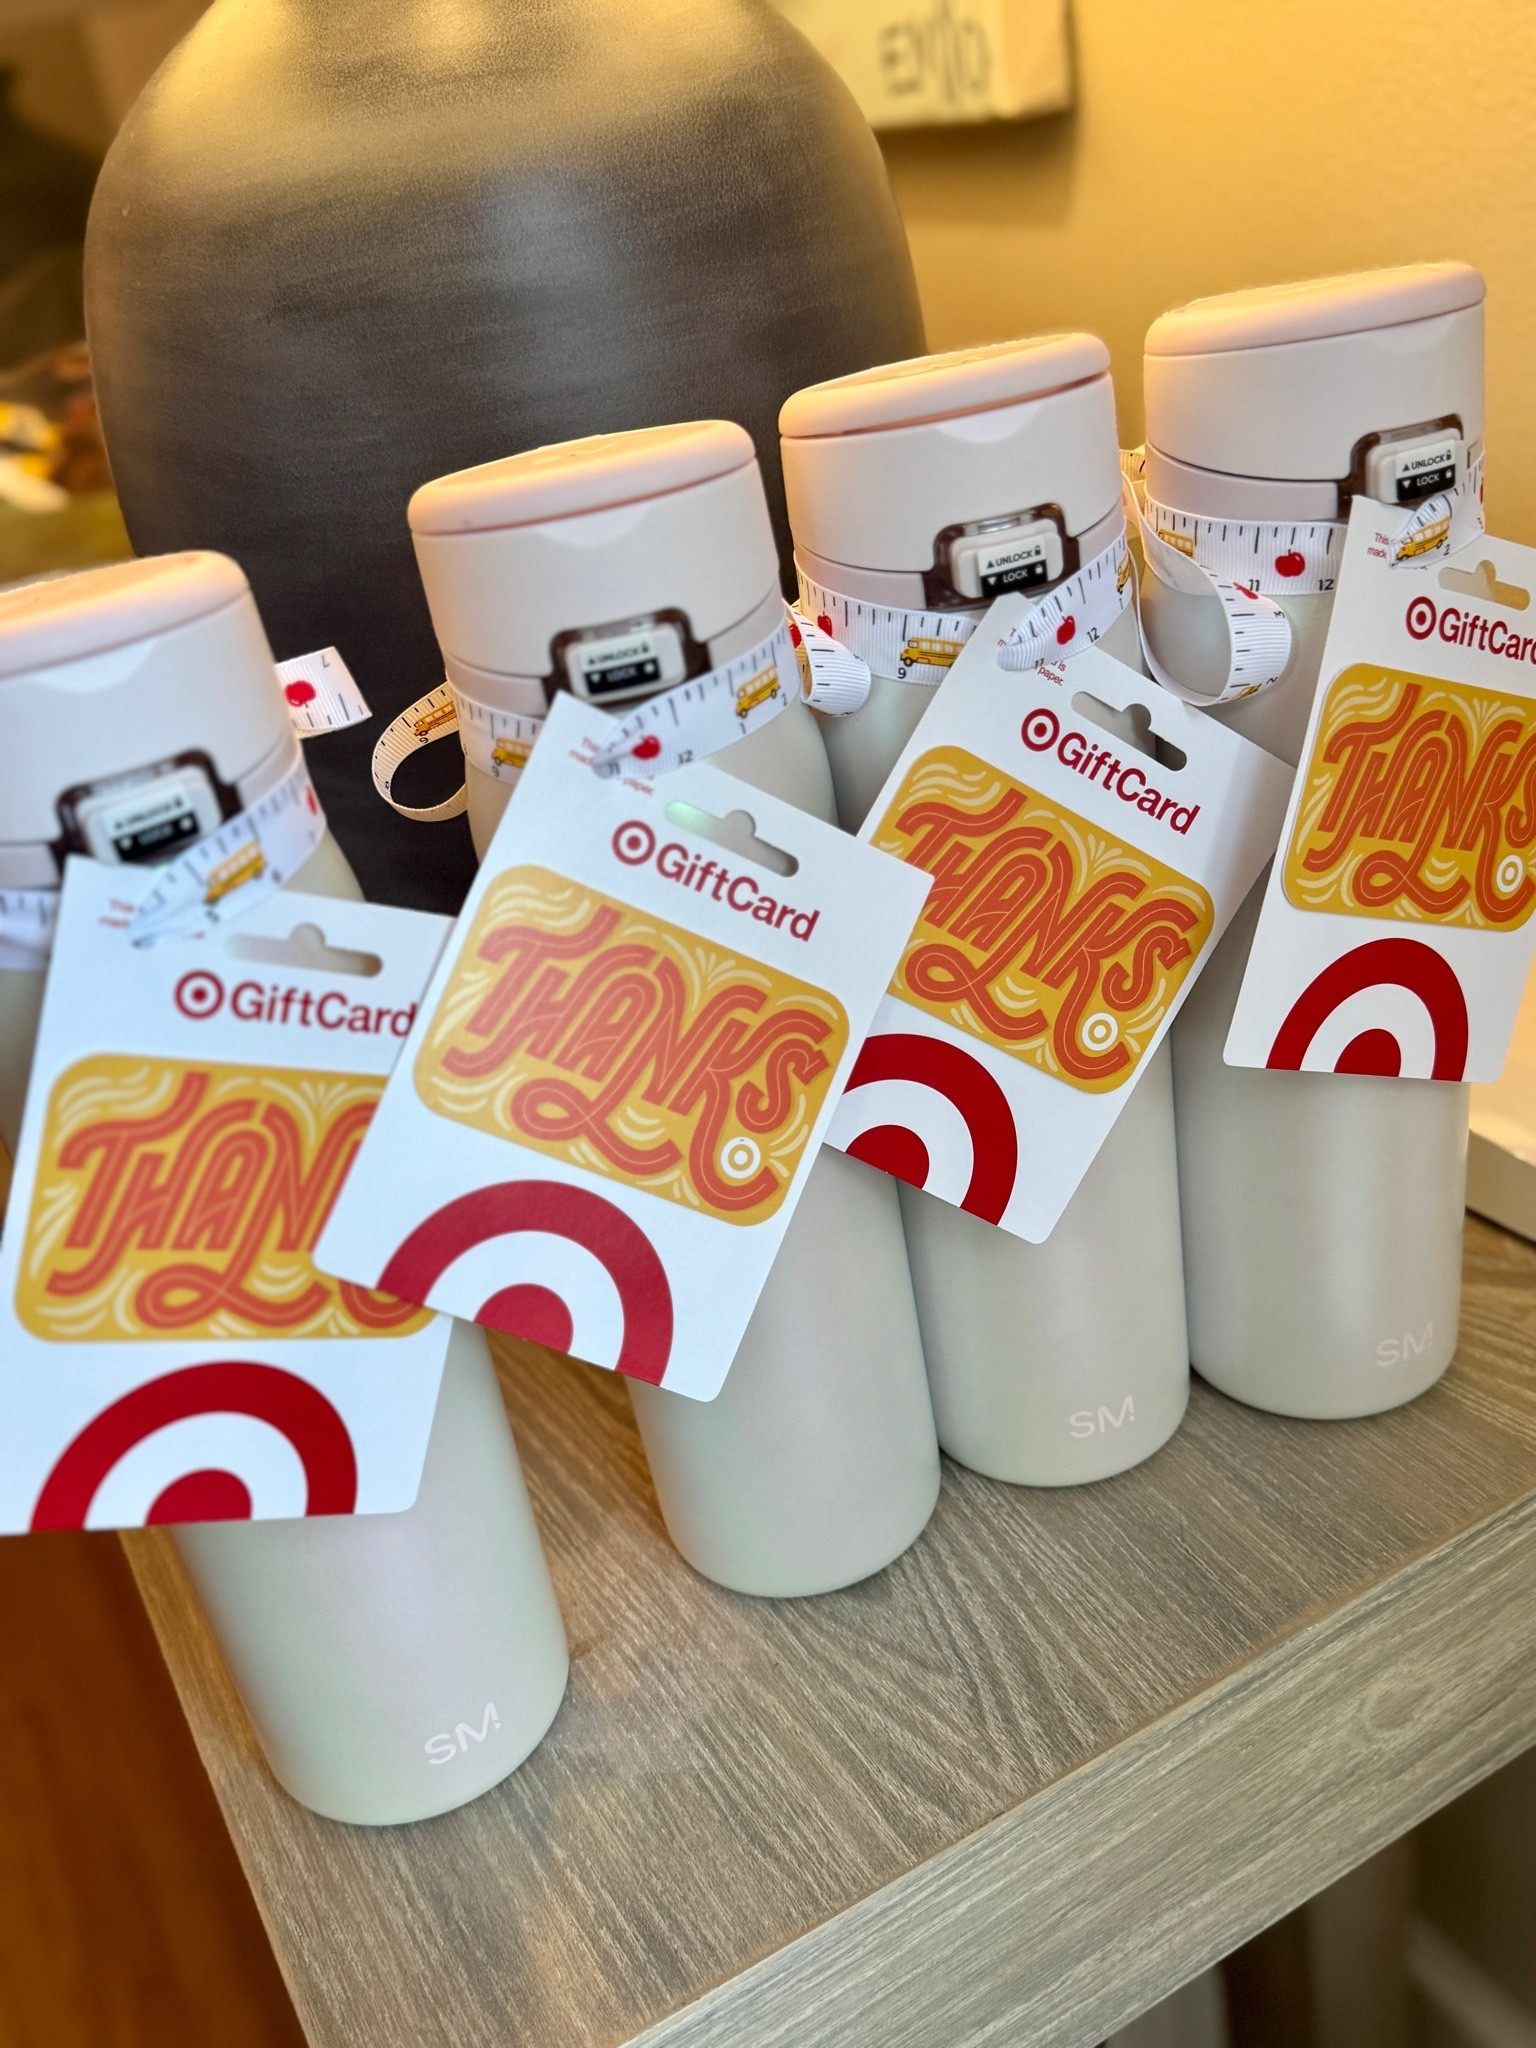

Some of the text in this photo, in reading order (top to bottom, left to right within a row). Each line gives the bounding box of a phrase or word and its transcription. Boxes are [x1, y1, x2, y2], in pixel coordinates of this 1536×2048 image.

[1411, 454, 1445, 470] UNLOCK
[1417, 473, 1440, 487] LOCK
[995, 550, 1033, 567] UNLOCK
[1003, 569, 1028, 583] LOCK
[1248, 578, 1334, 592] 11 12
[1086, 627, 1100, 643] 12
[897, 667, 907, 679] 9
[1037, 666, 1064, 687] paper.
[678, 750, 693, 765] 12
[1057, 733, 1200, 836] GiftCard
[656, 843, 821, 942] GiftCard
[895, 787, 1199, 1080] THANKS
[441, 905, 832, 1211] THANKS
